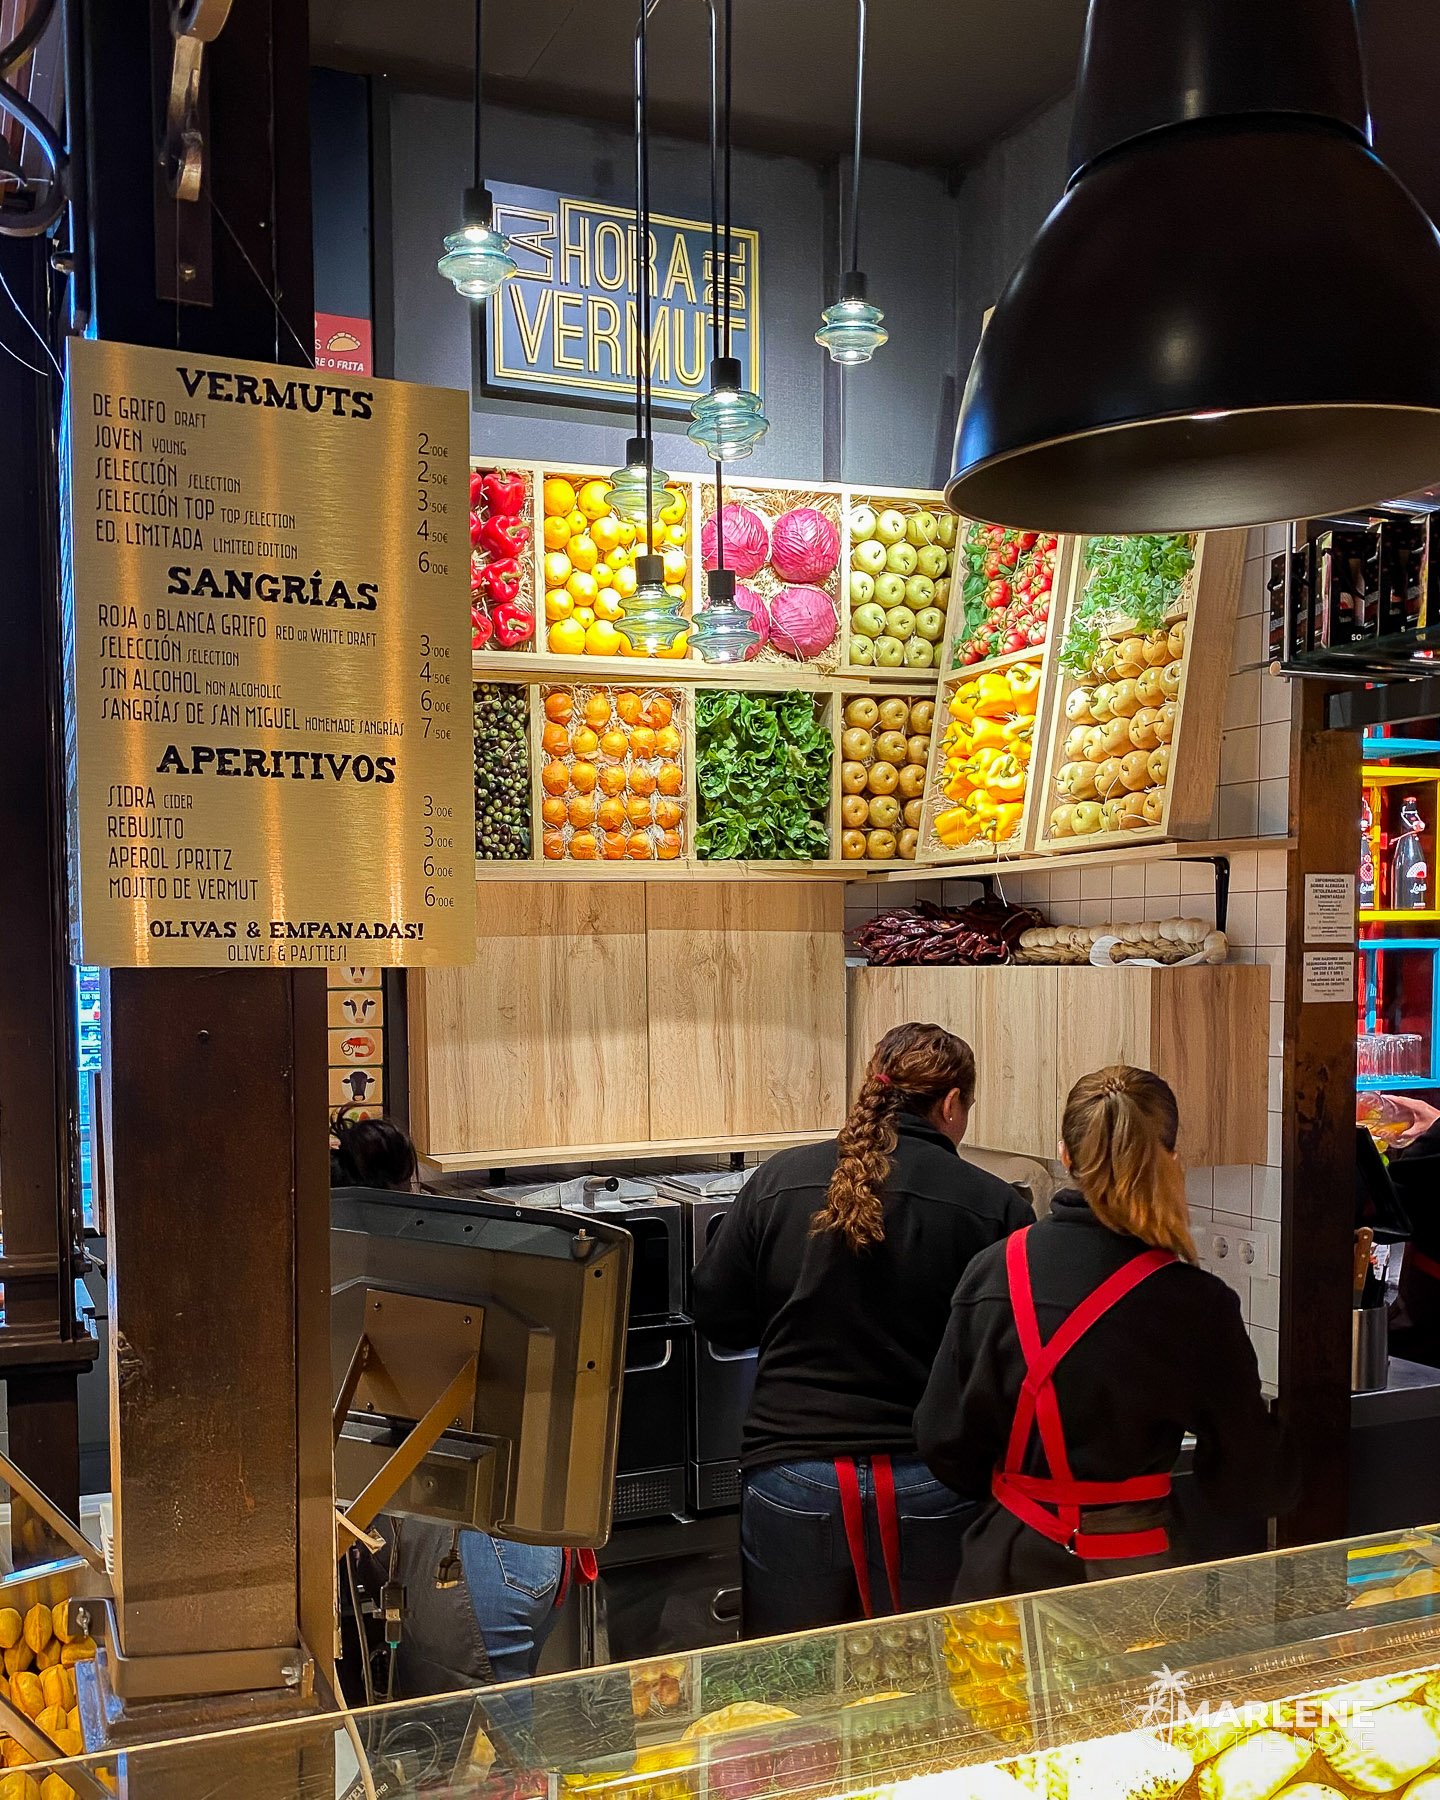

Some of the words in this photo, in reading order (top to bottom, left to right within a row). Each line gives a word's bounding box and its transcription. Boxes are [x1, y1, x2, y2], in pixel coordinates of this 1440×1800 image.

[560, 217, 697, 304] HORA
[703, 241, 747, 310] DEL
[509, 284, 747, 387] VERMUT
[328, 358, 335, 368] O
[337, 360, 364, 372] FRITA
[93, 393, 112, 417] DE
[119, 397, 166, 423] GRIFO
[174, 411, 206, 428] DRAFT
[176, 367, 374, 419] VERMUTS
[95, 425, 142, 452] JOVEN
[152, 438, 187, 456] YOUNG
[95, 457, 177, 487] SELECCIÓN
[188, 474, 241, 493] SELECTION
[96, 487, 178, 518] SELECCIÓN
[184, 497, 215, 521] TOP
[221, 508, 240, 524] TOP
[243, 510, 296, 529] SELECTION
[96, 519, 120, 544] ED.
[125, 522, 203, 550] LIMITADA
[213, 538, 254, 555] LIMITED
[257, 542, 298, 560] EDITION
[167, 566, 379, 611] SANGRÍAS
[99, 604, 138, 629] ROJA
[156, 608, 216, 635] BLANCA
[221, 614, 266, 638] GRIFO
[276, 625, 294, 641] RED
[311, 628, 344, 645] WHITE
[347, 631, 377, 647] DRAFT
[100, 634, 181, 662] SELECCIÓN
[186, 648, 239, 666] SELECTION
[101, 667, 127, 689] SIN
[133, 668, 201, 694] ALCOHOL
[205, 680, 226, 696] NON
[229, 682, 282, 699] ALCOHOLIC
[101, 695, 180, 723] SANGRÍAS
[186, 702, 204, 724] DE
[210, 704, 240, 726] SAN
[245, 706, 300, 730] MIGUEL
[305, 717, 355, 734] HOMEMADE
[358, 718, 405, 736] SANGRÍAS
[156, 745, 396, 784] APERITIVOS
[108, 785, 156, 809] SIDRA
[163, 794, 193, 809] CIDER
[107, 816, 184, 839] REBUJITO
[108, 847, 169, 869] APEROL
[175, 848, 232, 870] SPRITZ
[109, 877, 167, 899] MOJITO
[173, 878, 192, 899] DE
[198, 878, 258, 900] VERMUT
[150, 920, 237, 938] OLIVAS
[246, 921, 261, 938] &
[269, 921, 424, 940] EMPANADAS!
[228, 944, 271, 962] OLIVES
[290, 945, 347, 962] PASTIES!
